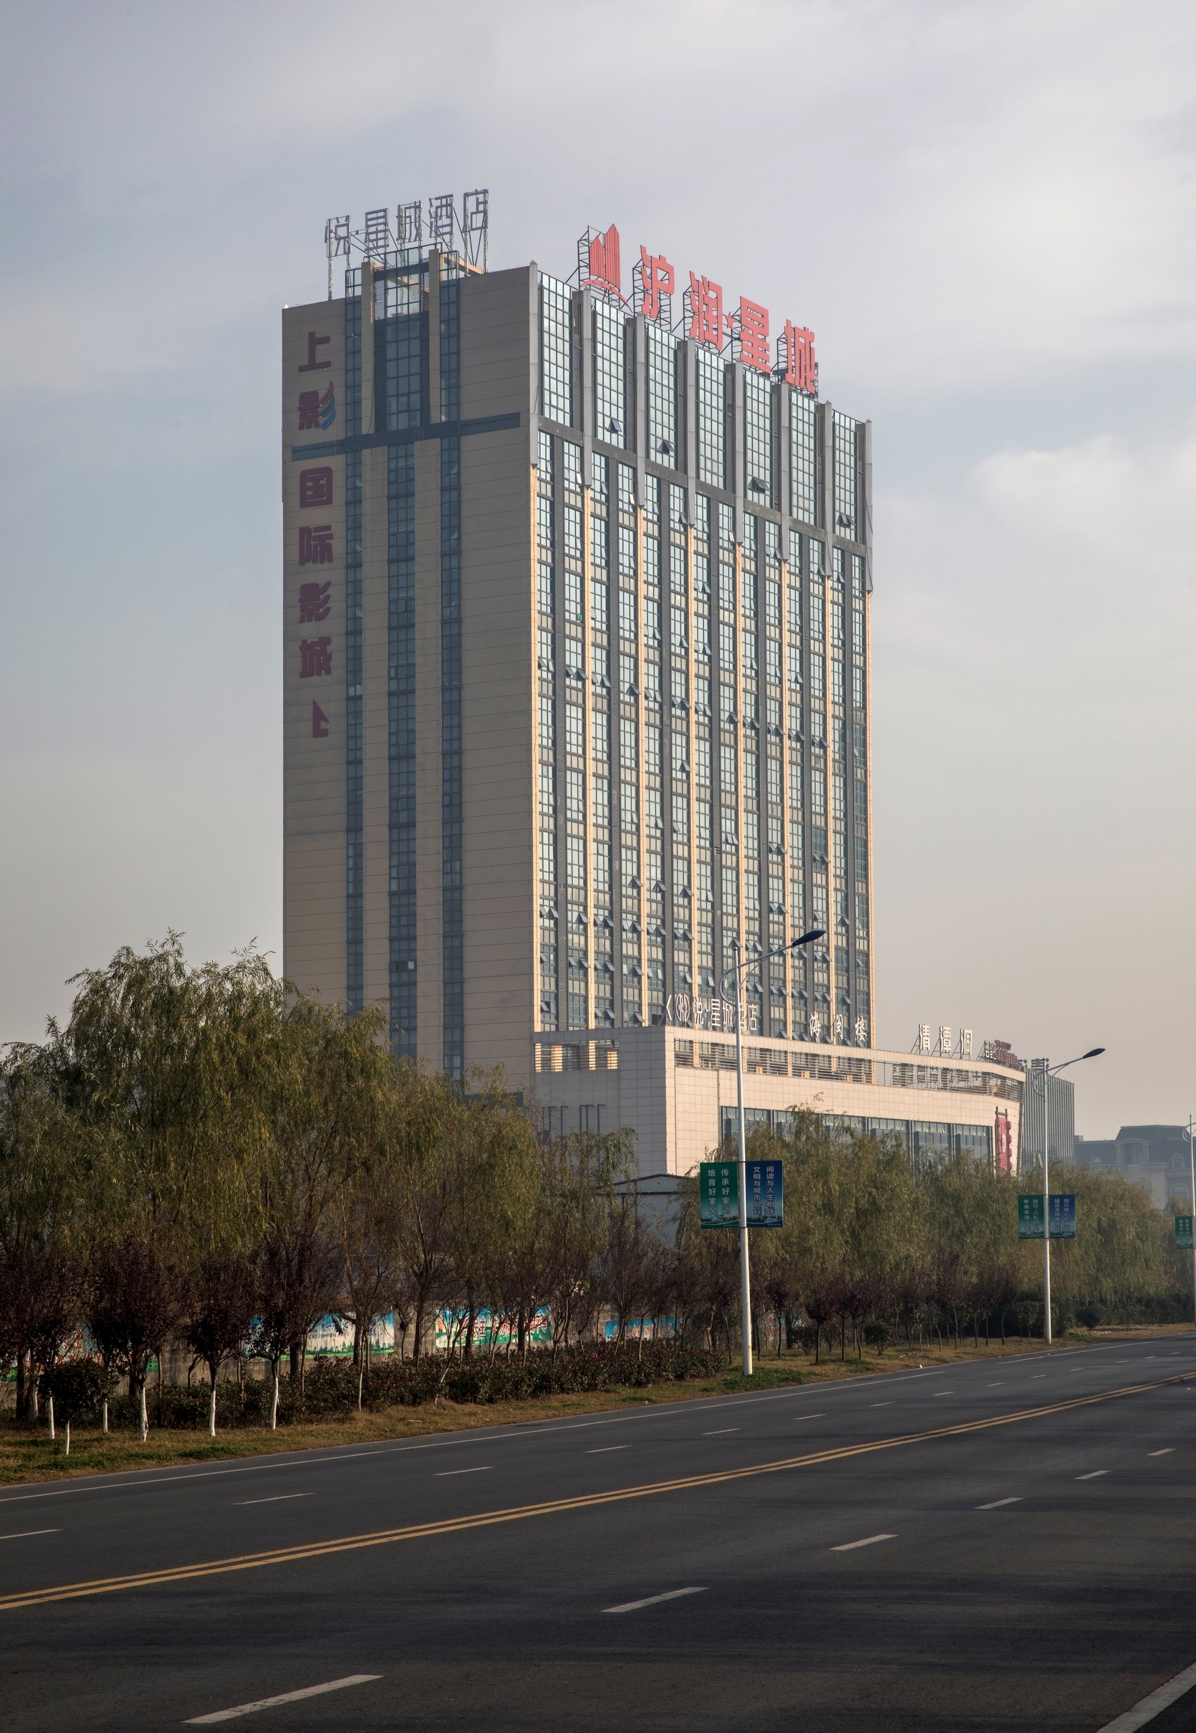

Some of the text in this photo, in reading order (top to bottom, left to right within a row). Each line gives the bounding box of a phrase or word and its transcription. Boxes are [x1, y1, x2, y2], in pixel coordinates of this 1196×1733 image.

[298, 331, 336, 679] 上影国际影城
[708, 1169, 718, 1215] 培育好家风
[721, 1168, 731, 1215] 传承好家训
[753, 1166, 761, 1216] 文明与城市同行
[766, 1166, 775, 1216] 阅读与人生相伴
